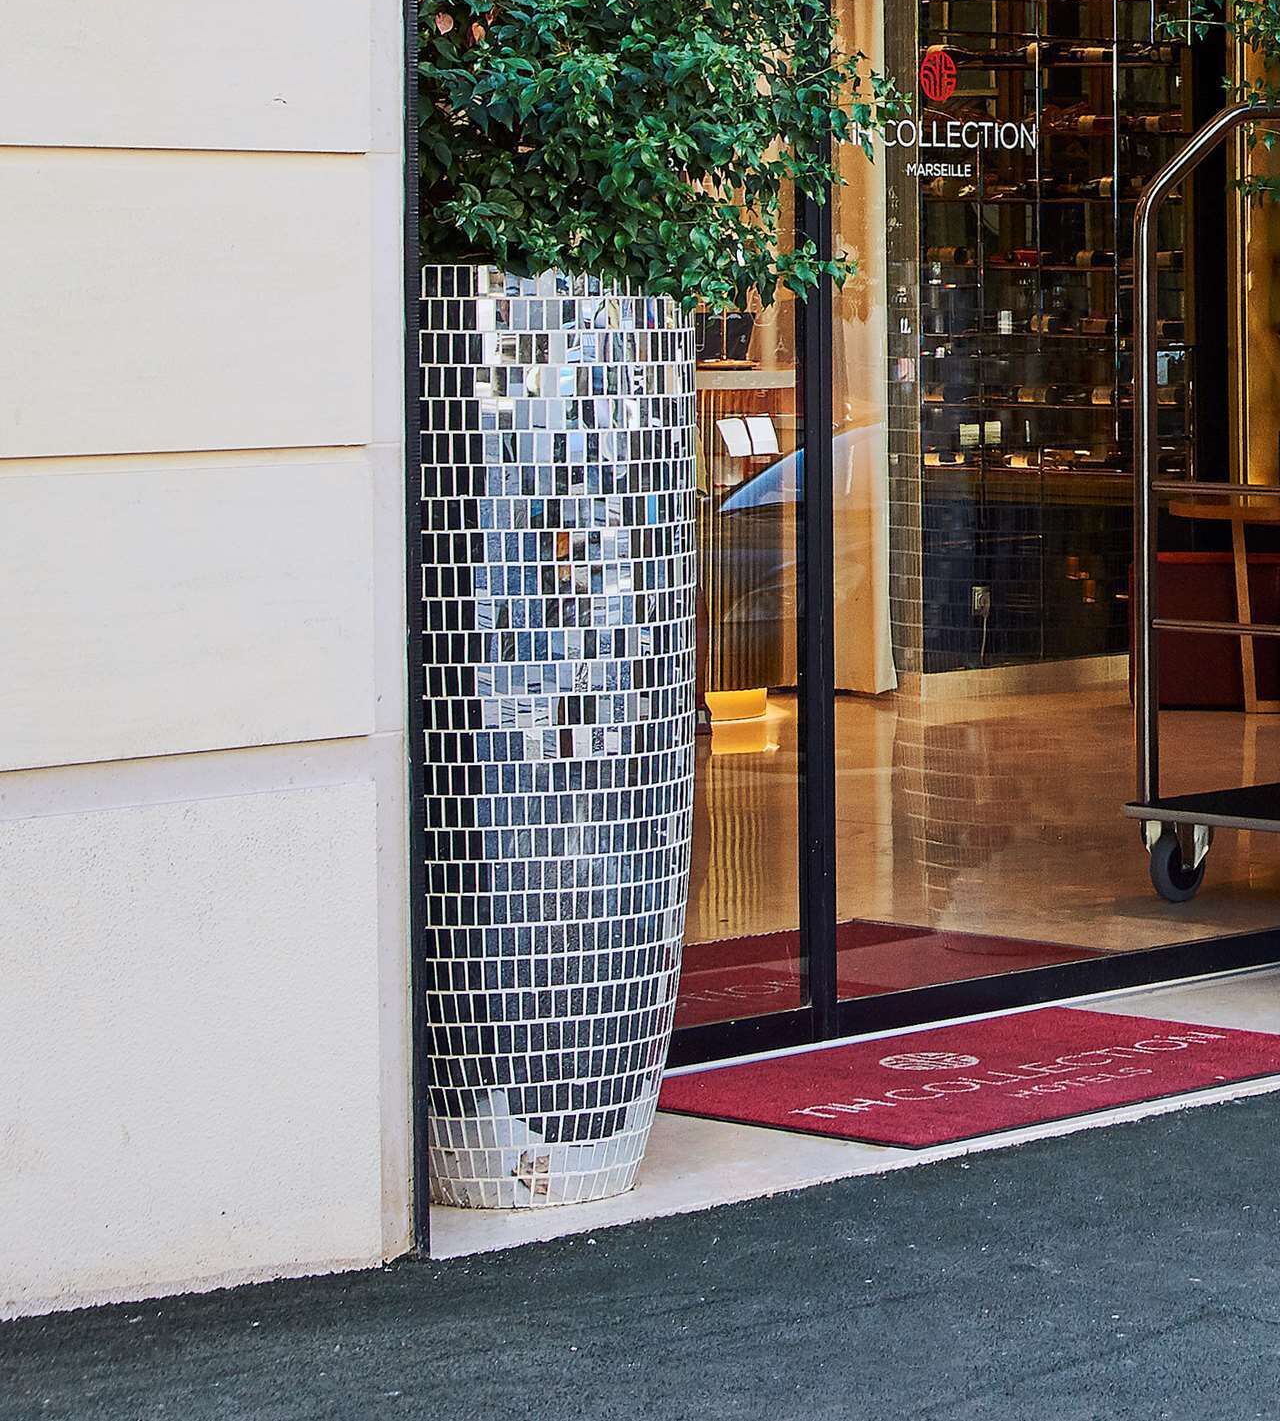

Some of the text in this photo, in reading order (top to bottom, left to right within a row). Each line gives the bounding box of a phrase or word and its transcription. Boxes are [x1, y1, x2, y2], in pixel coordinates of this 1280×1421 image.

[880, 119, 1038, 150] COLLECTION
[906, 163, 972, 177] MARSEILLE
[884, 1031, 1227, 1101] COLLECTION
